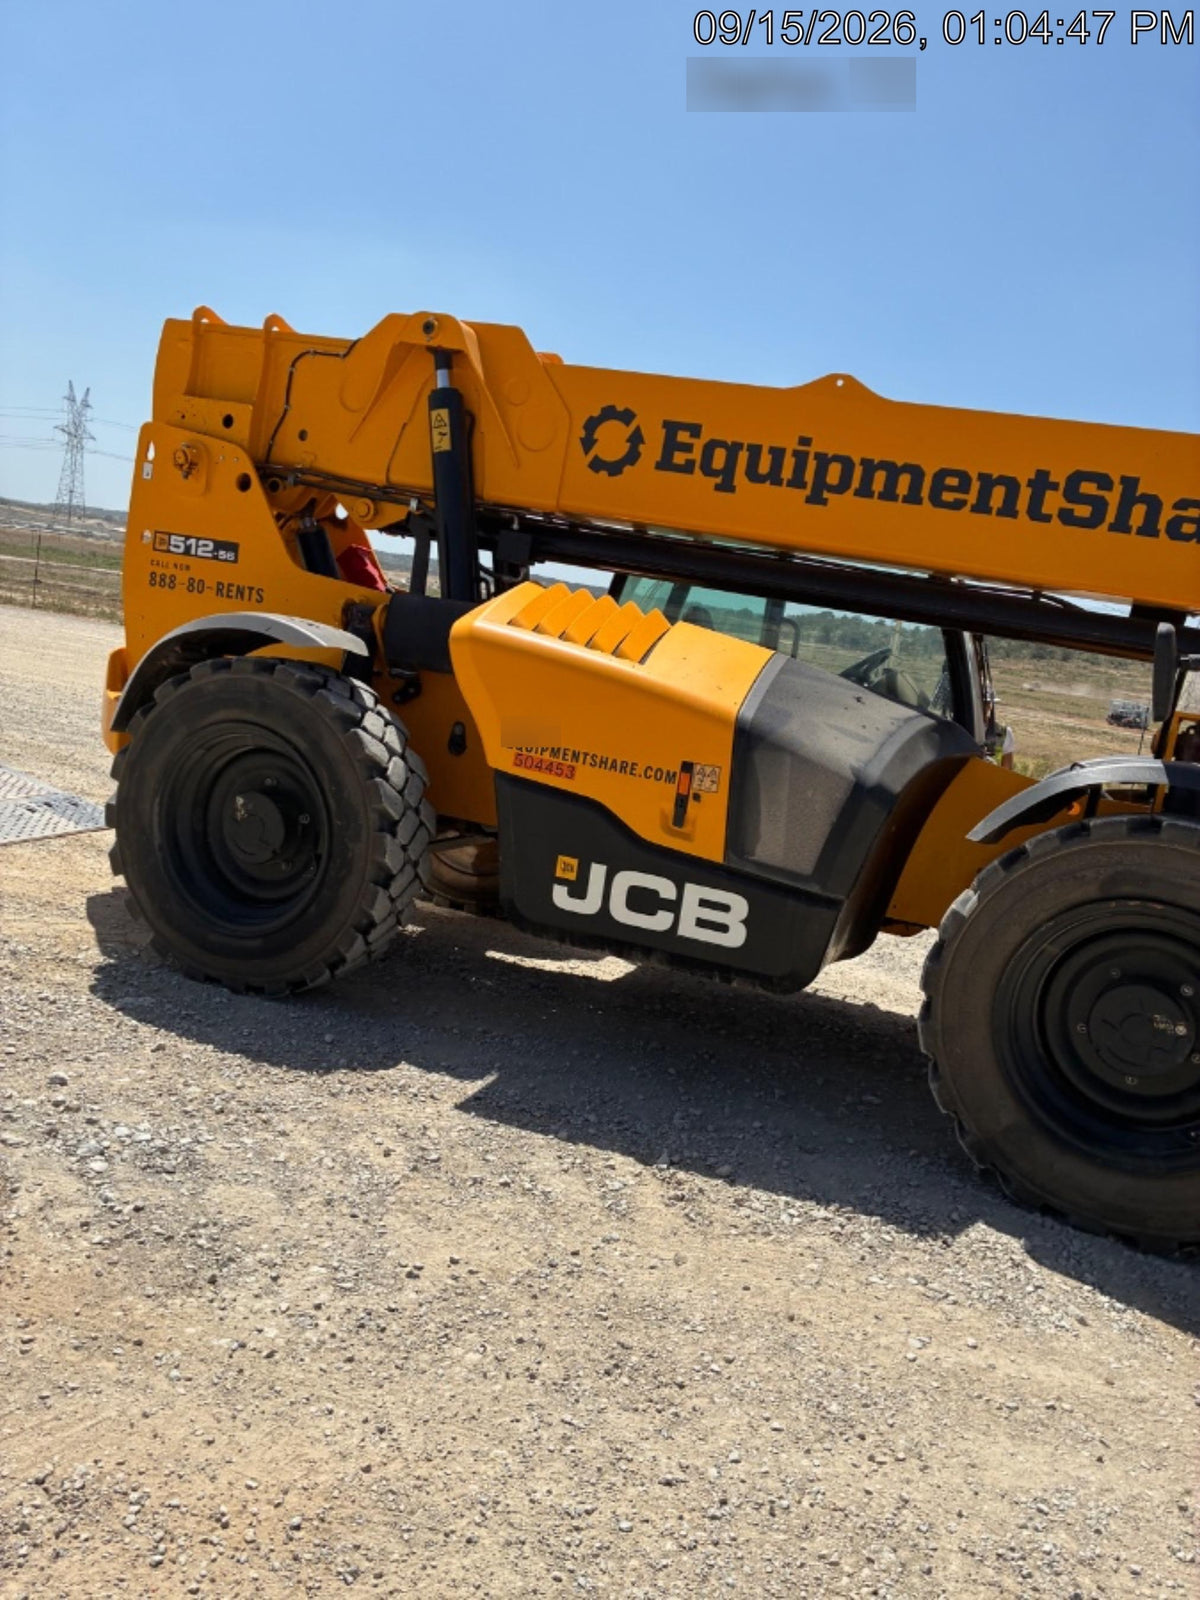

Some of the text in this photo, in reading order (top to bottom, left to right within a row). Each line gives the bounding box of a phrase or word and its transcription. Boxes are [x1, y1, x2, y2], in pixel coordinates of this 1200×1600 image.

[655, 420, 1200, 544] EquipmentSha
[150, 559, 169, 569] CALL
[149, 571, 264, 604] 888-80-RENTS
[506, 746, 678, 785] IPMENTSHARE.COM
[514, 752, 575, 779] 504453
[552, 862, 749, 949] JCB
